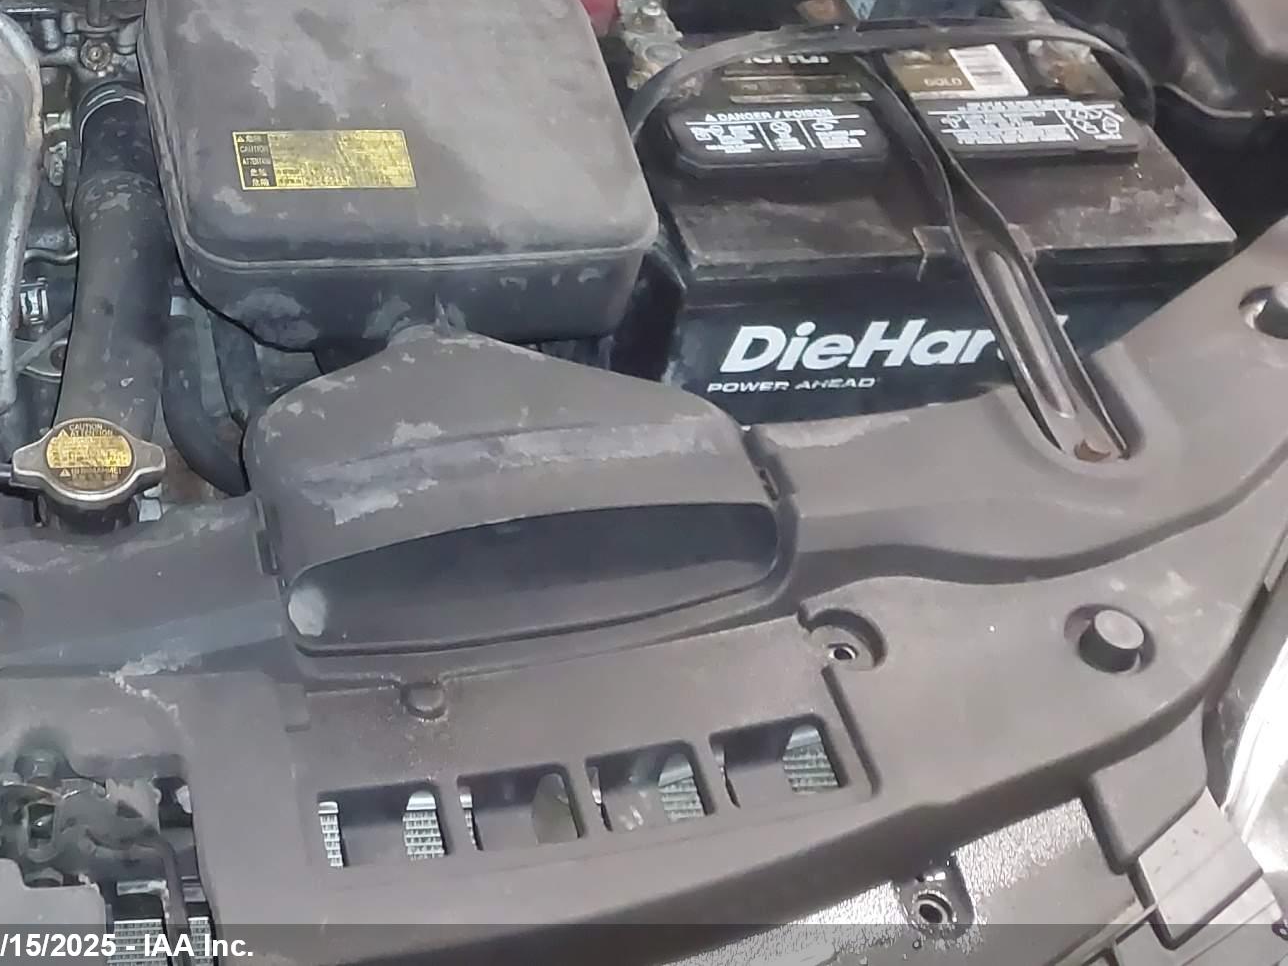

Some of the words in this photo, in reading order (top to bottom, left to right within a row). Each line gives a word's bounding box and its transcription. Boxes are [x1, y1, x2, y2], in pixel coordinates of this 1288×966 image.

[717, 112, 772, 122] DANGER
[783, 108, 834, 118] POISON
[719, 318, 1069, 372] DieHar
[707, 382, 790, 393] POWER
[794, 377, 876, 390] AHEAD
[69, 423, 103, 432] CAUTION
